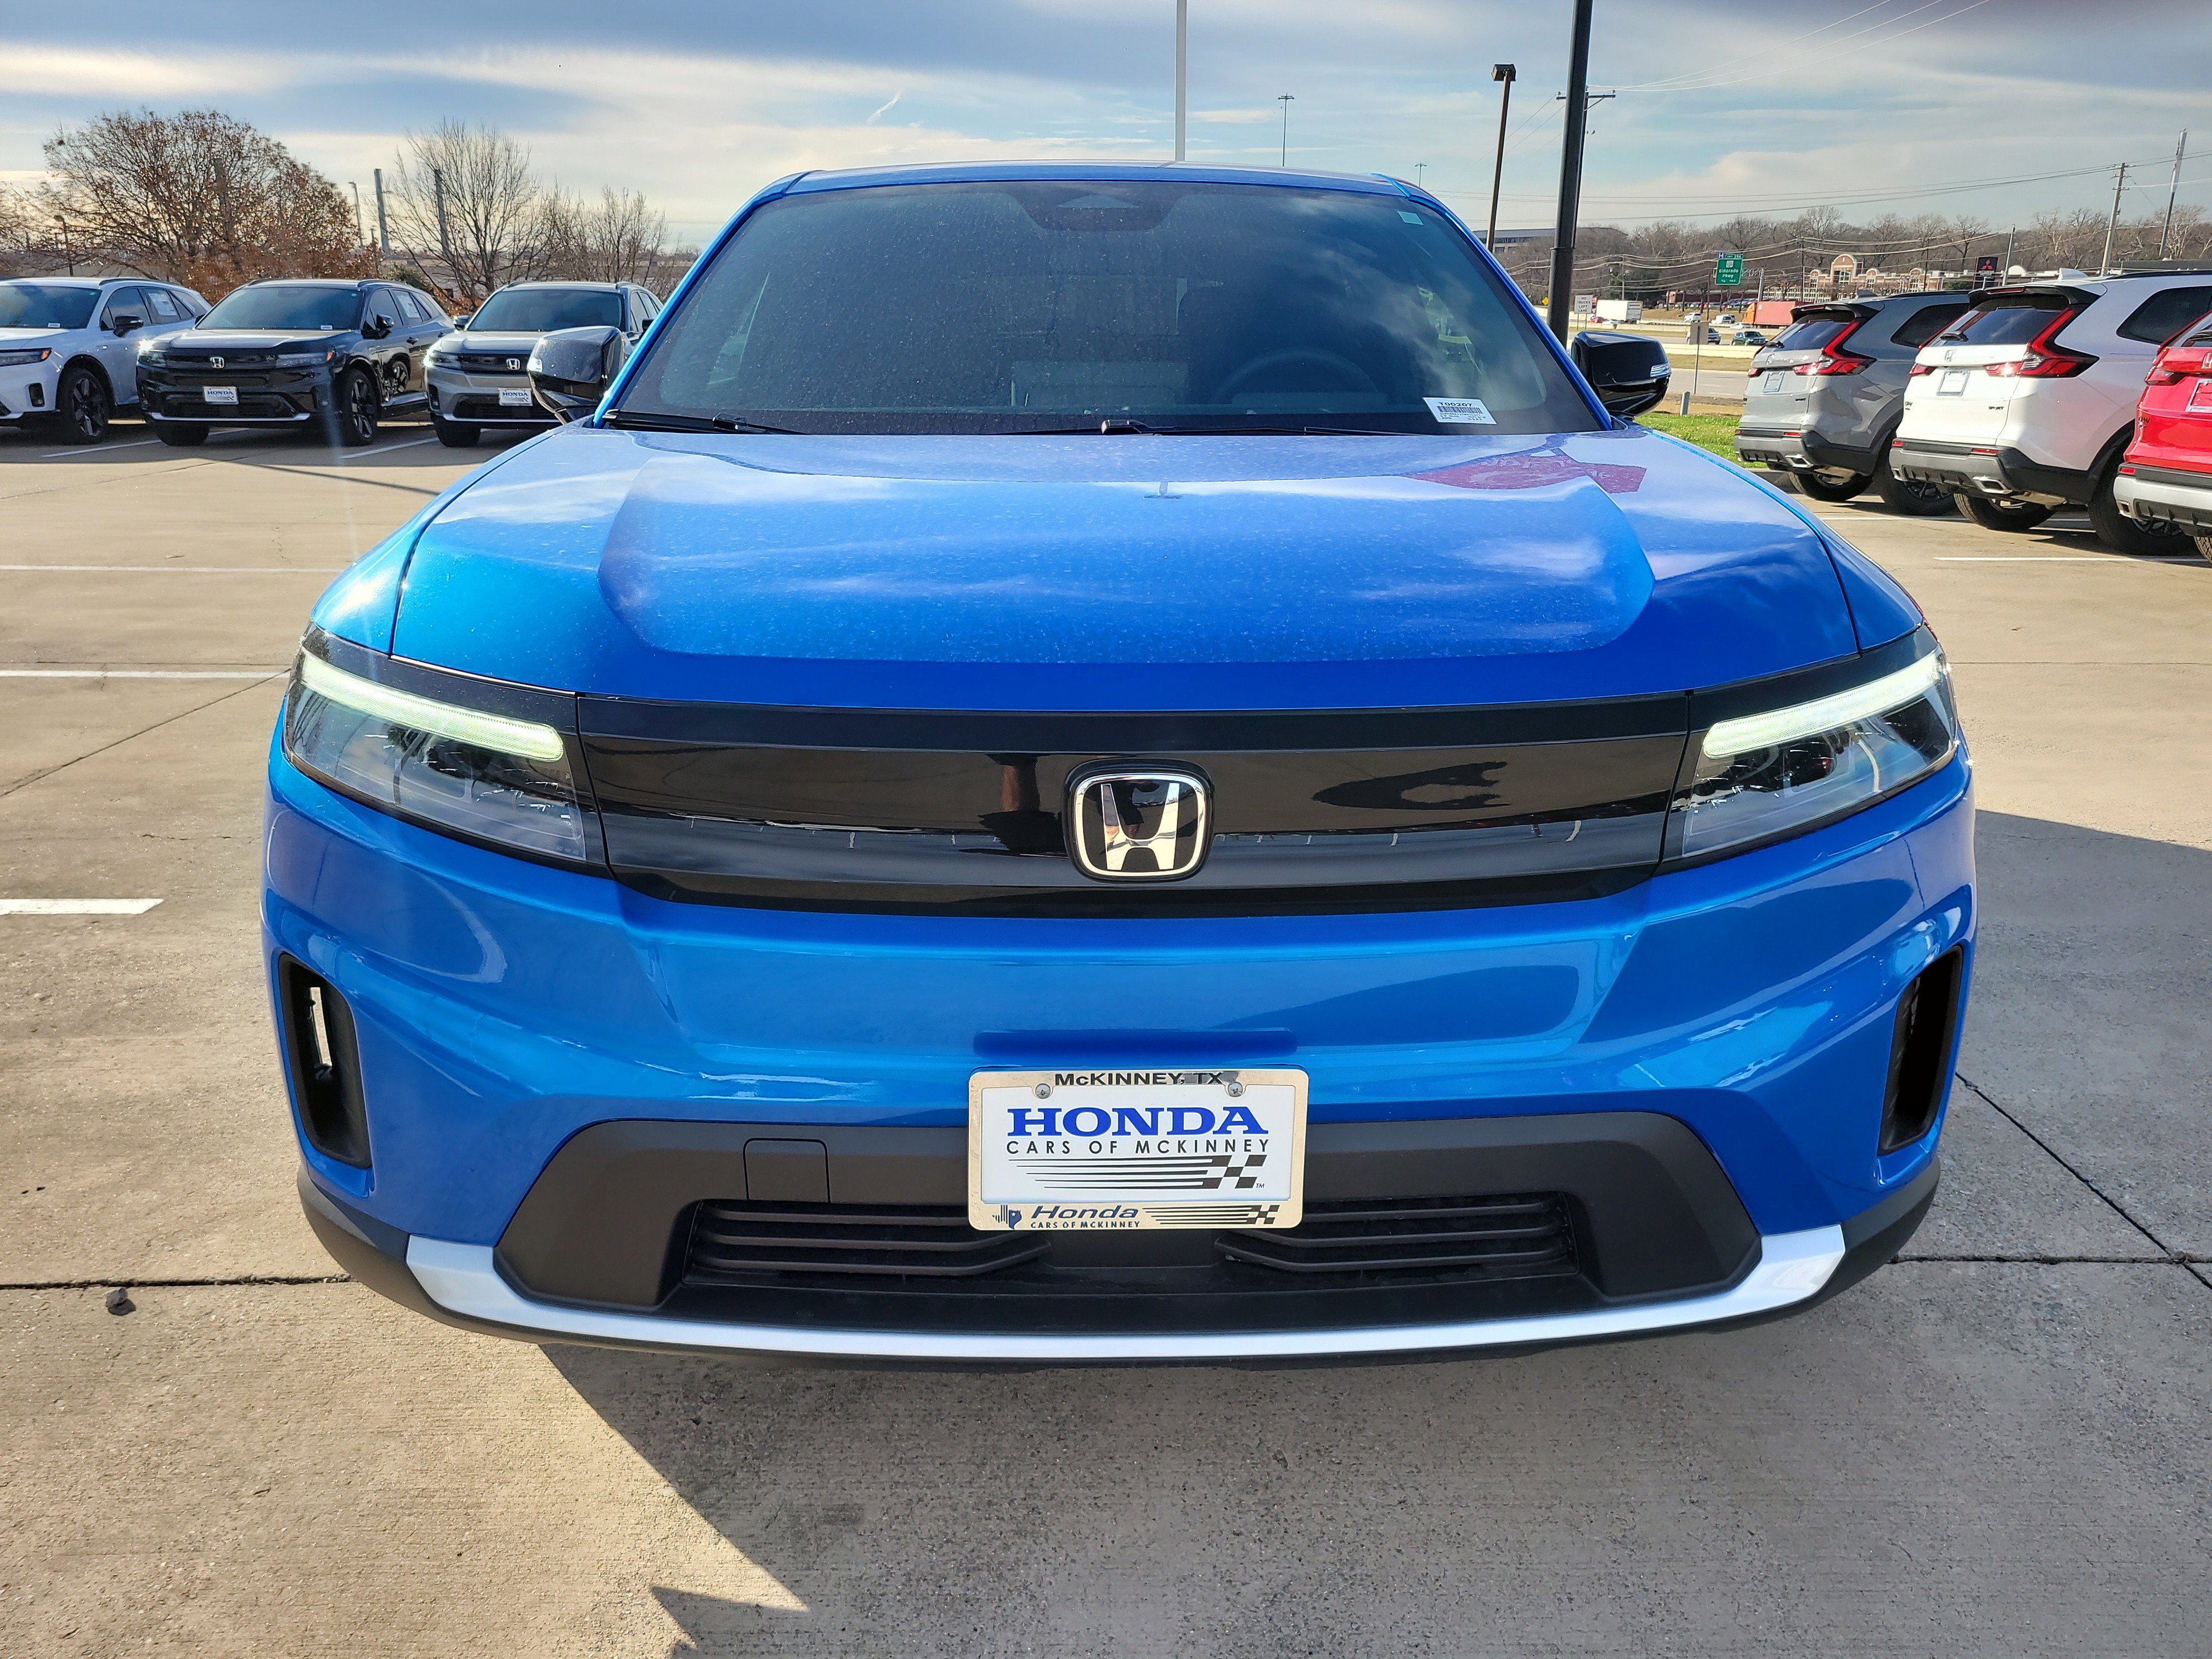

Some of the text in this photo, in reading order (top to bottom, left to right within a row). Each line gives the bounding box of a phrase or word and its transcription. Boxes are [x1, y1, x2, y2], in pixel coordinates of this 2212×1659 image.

[1054, 1072, 1223, 1086] McKINNEY, TX
[1007, 1106, 1269, 1137] HONDA
[1007, 1139, 1269, 1154] CARS OF MCKINNEY
[1031, 1205, 1139, 1219] Honda
